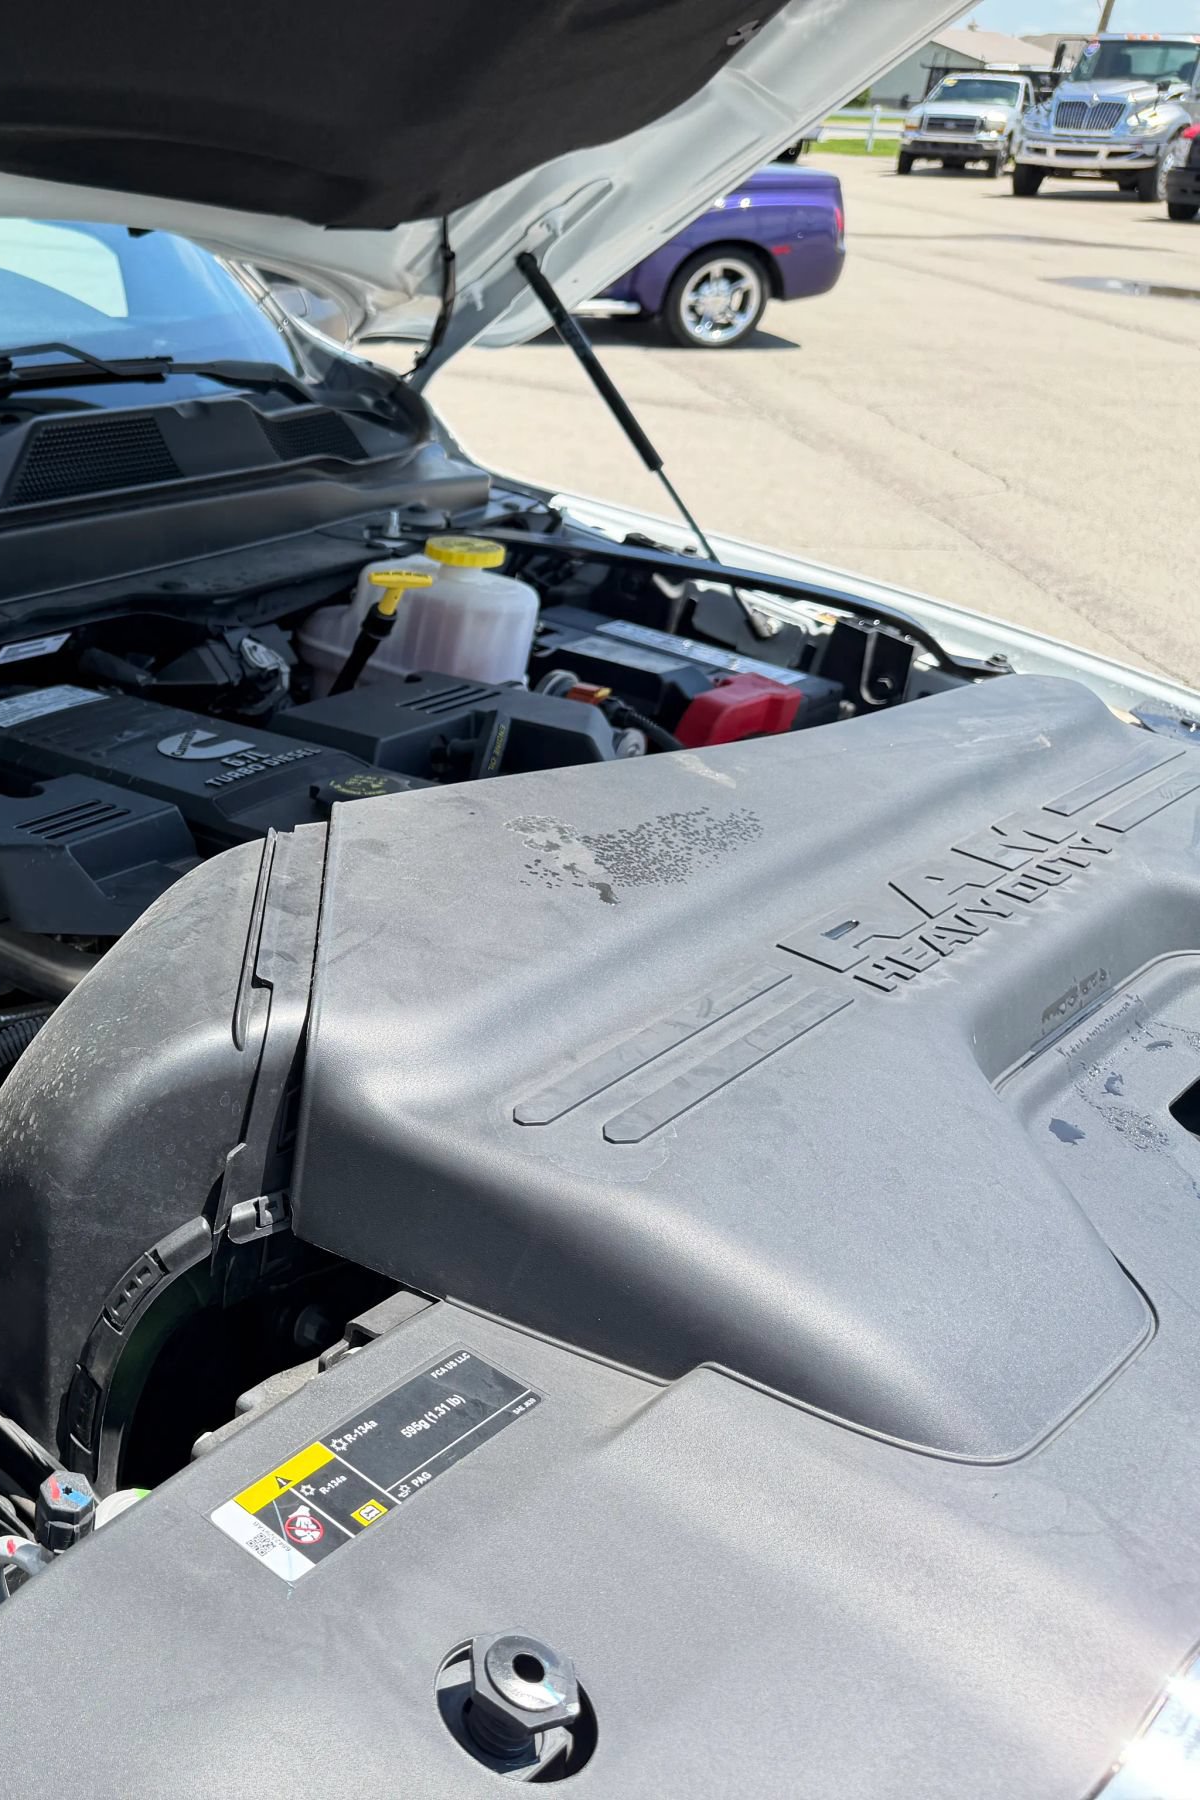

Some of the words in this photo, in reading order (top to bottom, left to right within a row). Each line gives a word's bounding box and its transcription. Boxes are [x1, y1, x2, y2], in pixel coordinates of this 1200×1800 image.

[204, 762, 267, 787] TURBO
[261, 747, 322, 768] DIESEL
[220, 750, 272, 768] 6.7L
[776, 811, 1079, 974] RAM
[853, 898, 1014, 993] HEAVY
[995, 836, 1114, 904] DUTY
[430, 1366, 448, 1379] FCA
[444, 1359, 459, 1371] US
[454, 1351, 471, 1364] LLC
[400, 1420, 431, 1438] 595g
[424, 1402, 451, 1424] (1.31
[445, 1394, 467, 1408] lb)
[343, 1419, 378, 1444] R-134a
[319, 1474, 348, 1496] R-134a
[410, 1471, 433, 1488] PAG
